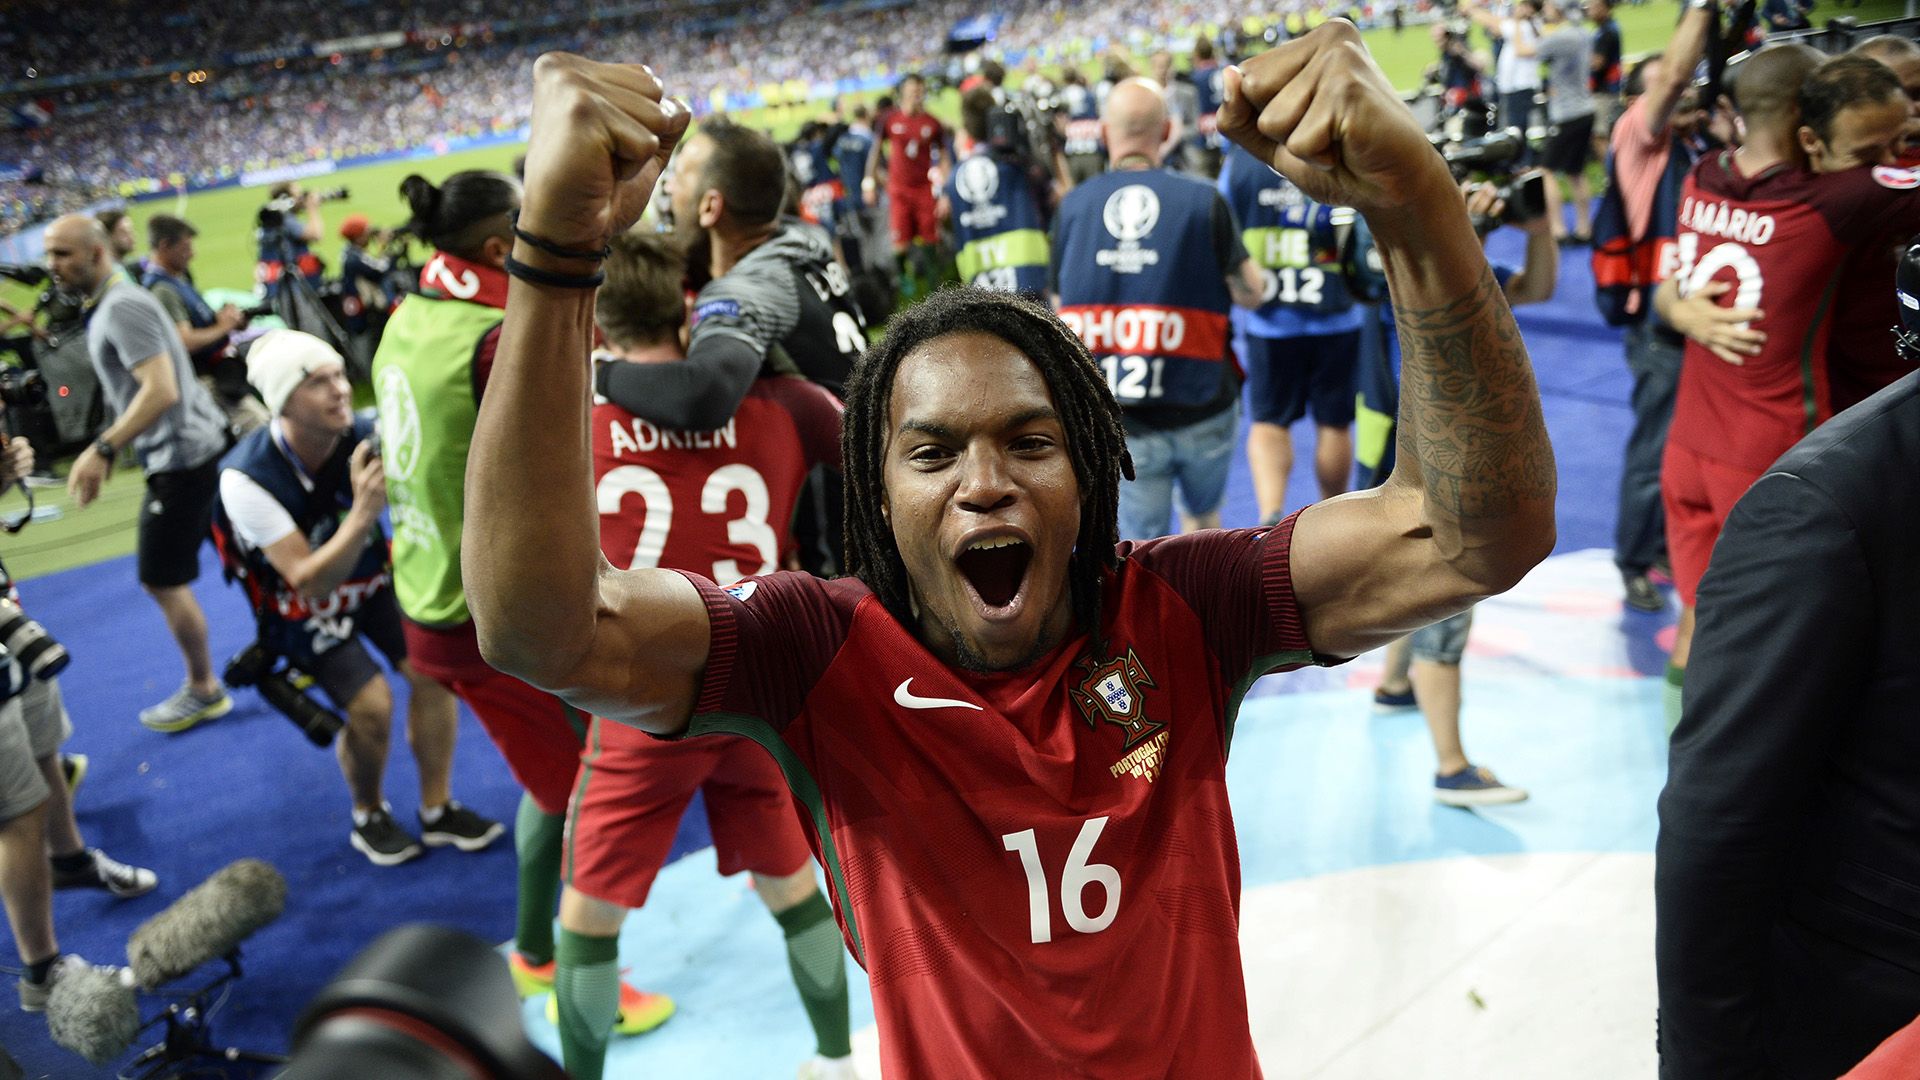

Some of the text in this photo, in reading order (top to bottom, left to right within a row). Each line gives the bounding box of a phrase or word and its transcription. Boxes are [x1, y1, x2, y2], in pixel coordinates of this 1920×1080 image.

[1264, 229, 1310, 265] HE
[1058, 308, 1185, 351] PHOTO
[1099, 355, 1165, 399] 121
[596, 463, 778, 588] 23
[1001, 815, 1122, 944] 16
